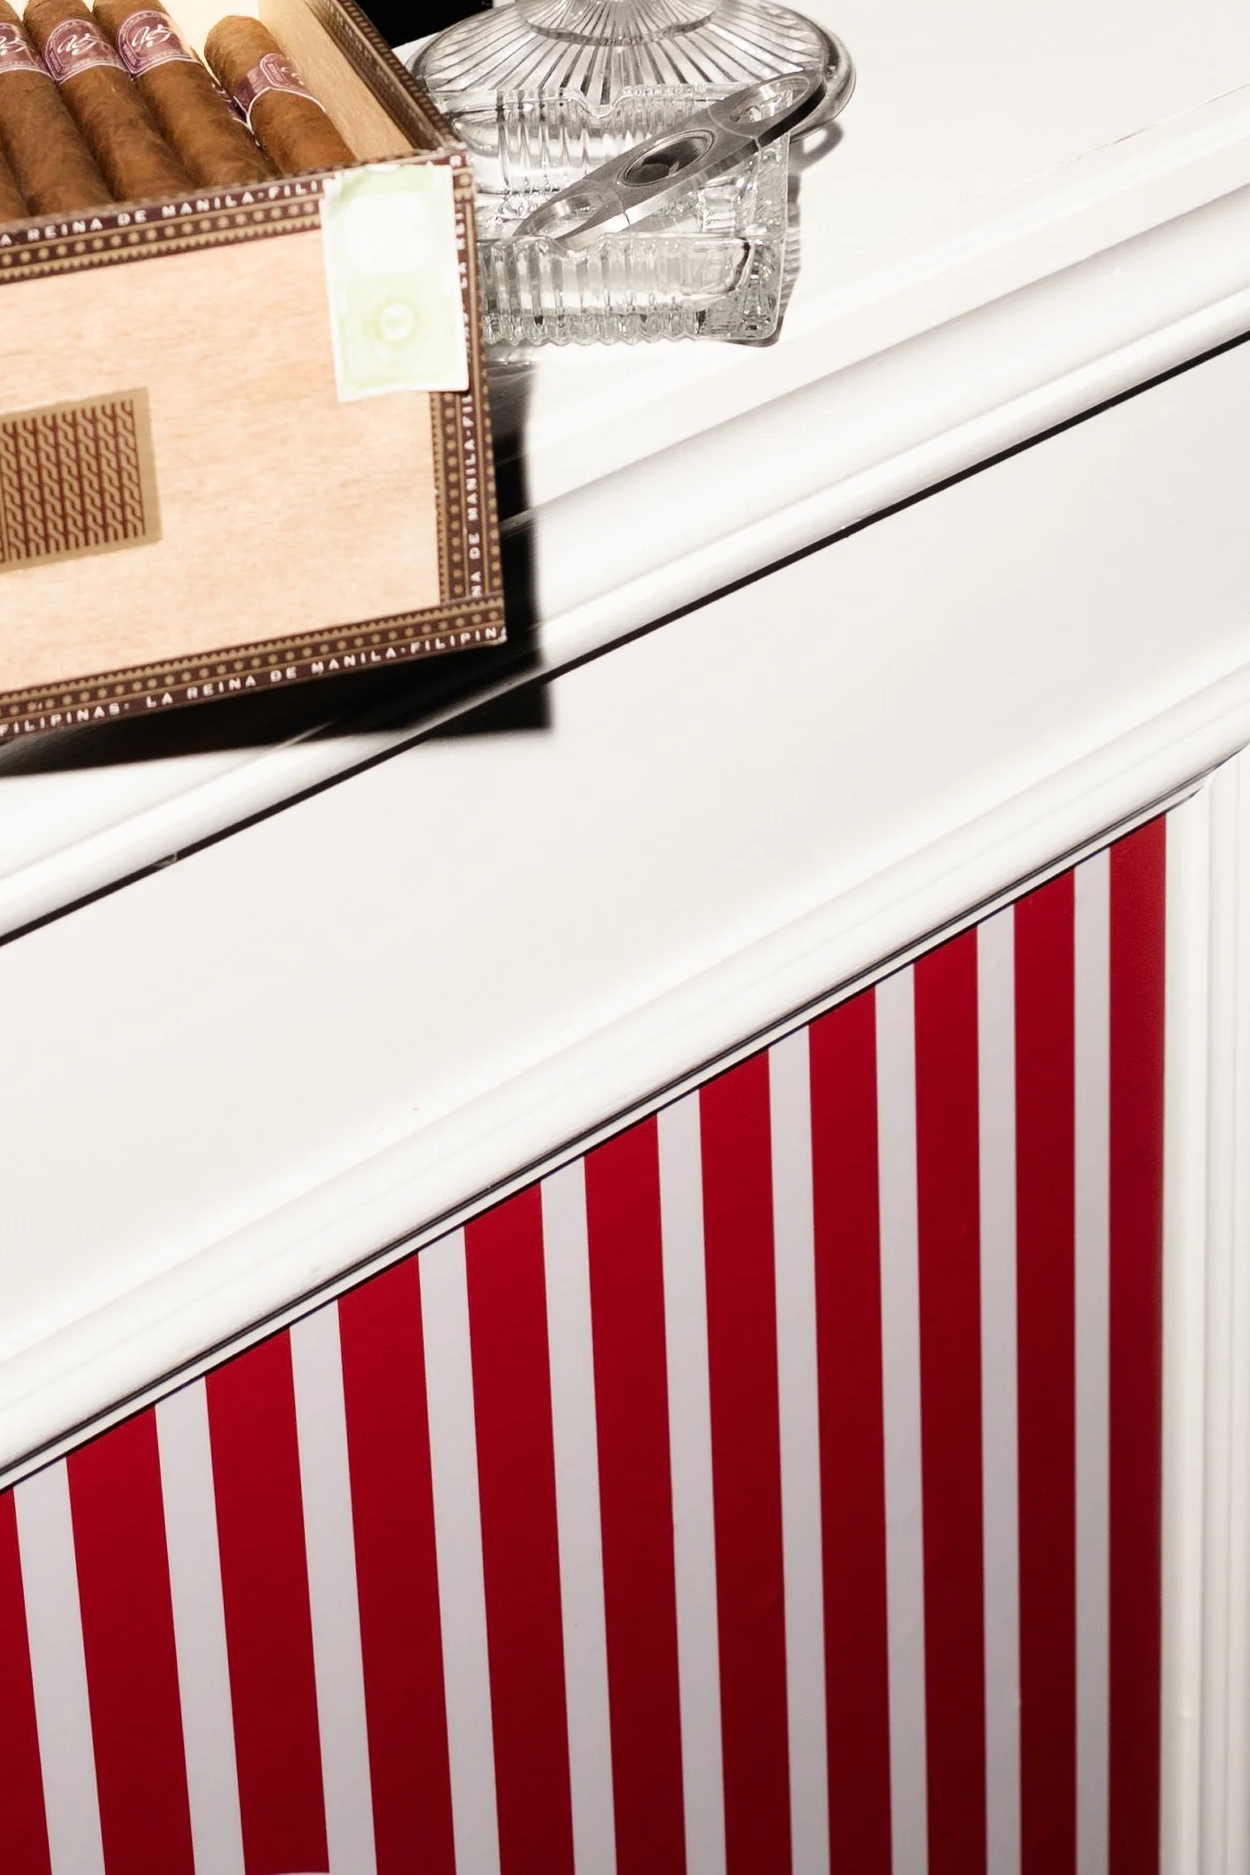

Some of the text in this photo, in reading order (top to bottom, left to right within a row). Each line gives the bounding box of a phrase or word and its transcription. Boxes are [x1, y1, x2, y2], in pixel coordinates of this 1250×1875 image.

[25, 216, 103, 242] REINA
[116, 208, 148, 227] DE
[467, 532, 481, 559] DE
[144, 691, 174, 708] LA
[185, 674, 257, 700] REINA
[268, 665, 298, 683] DE
